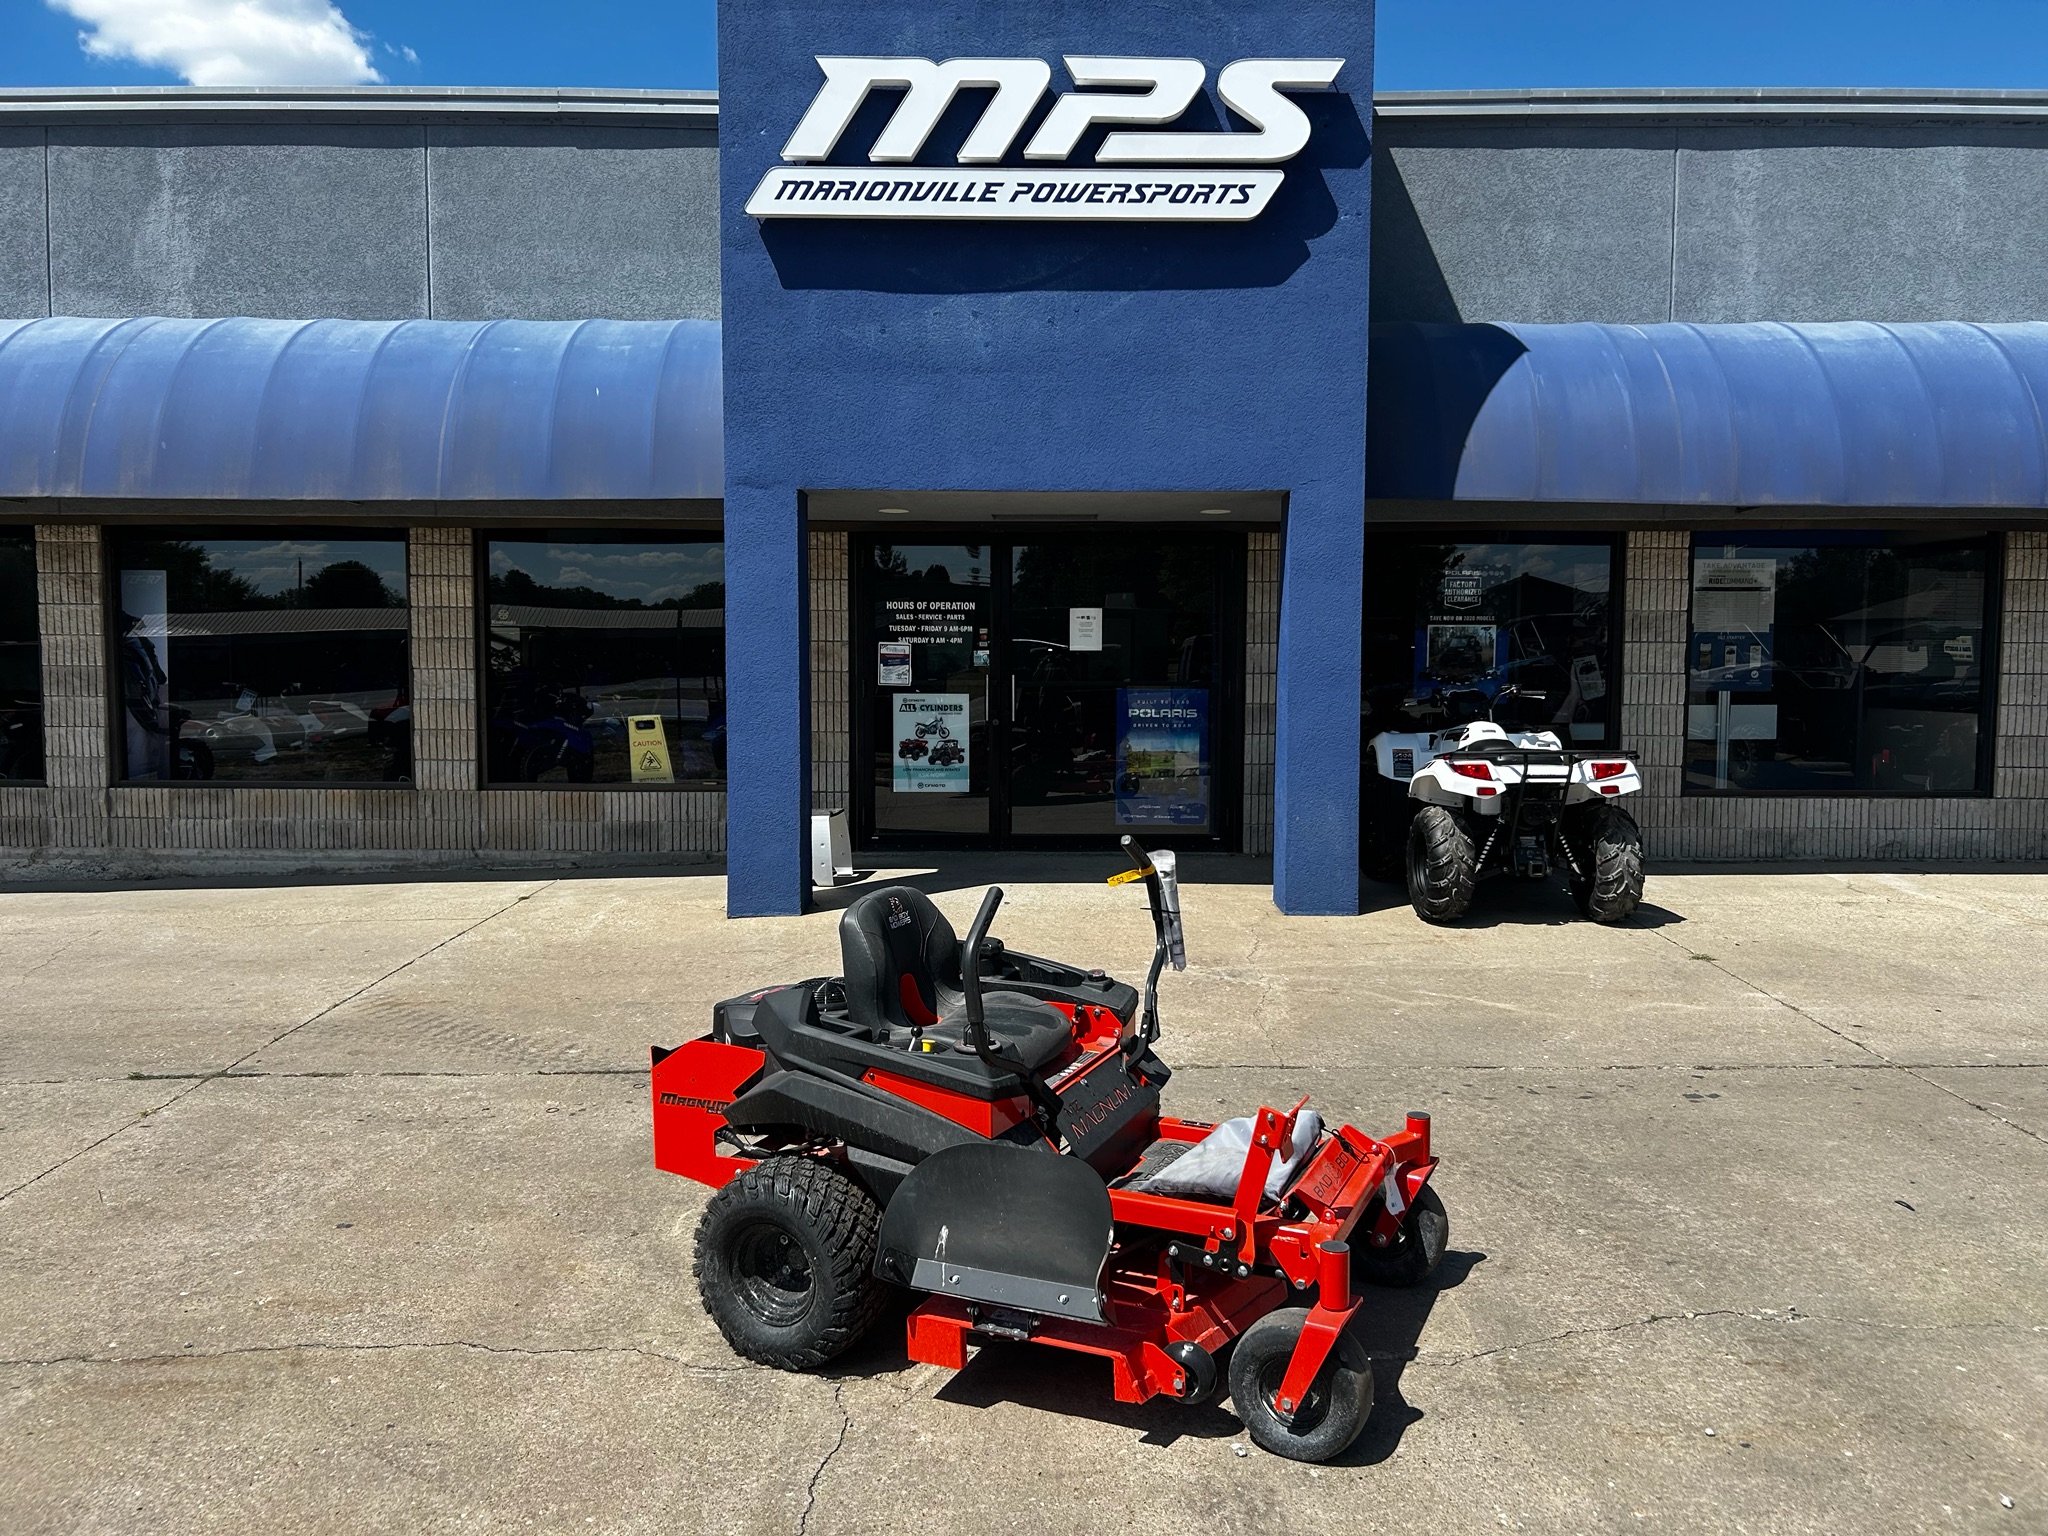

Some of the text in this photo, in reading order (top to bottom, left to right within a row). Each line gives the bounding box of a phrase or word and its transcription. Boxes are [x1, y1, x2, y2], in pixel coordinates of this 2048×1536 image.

[780, 55, 1346, 163] MPS
[775, 180, 1257, 204] MARIONVILLE POWERSPORTS
[1445, 588, 1482, 596] AUTHORIZED
[886, 601, 976, 611] HOURS OF OPERATION
[919, 704, 963, 712] CYLINDERS
[1128, 708, 1198, 718] POLARIS
[632, 740, 663, 748] CAUTION
[1071, 1082, 1132, 1140] MAGNUM
[1313, 1173, 1333, 1198] BAD
